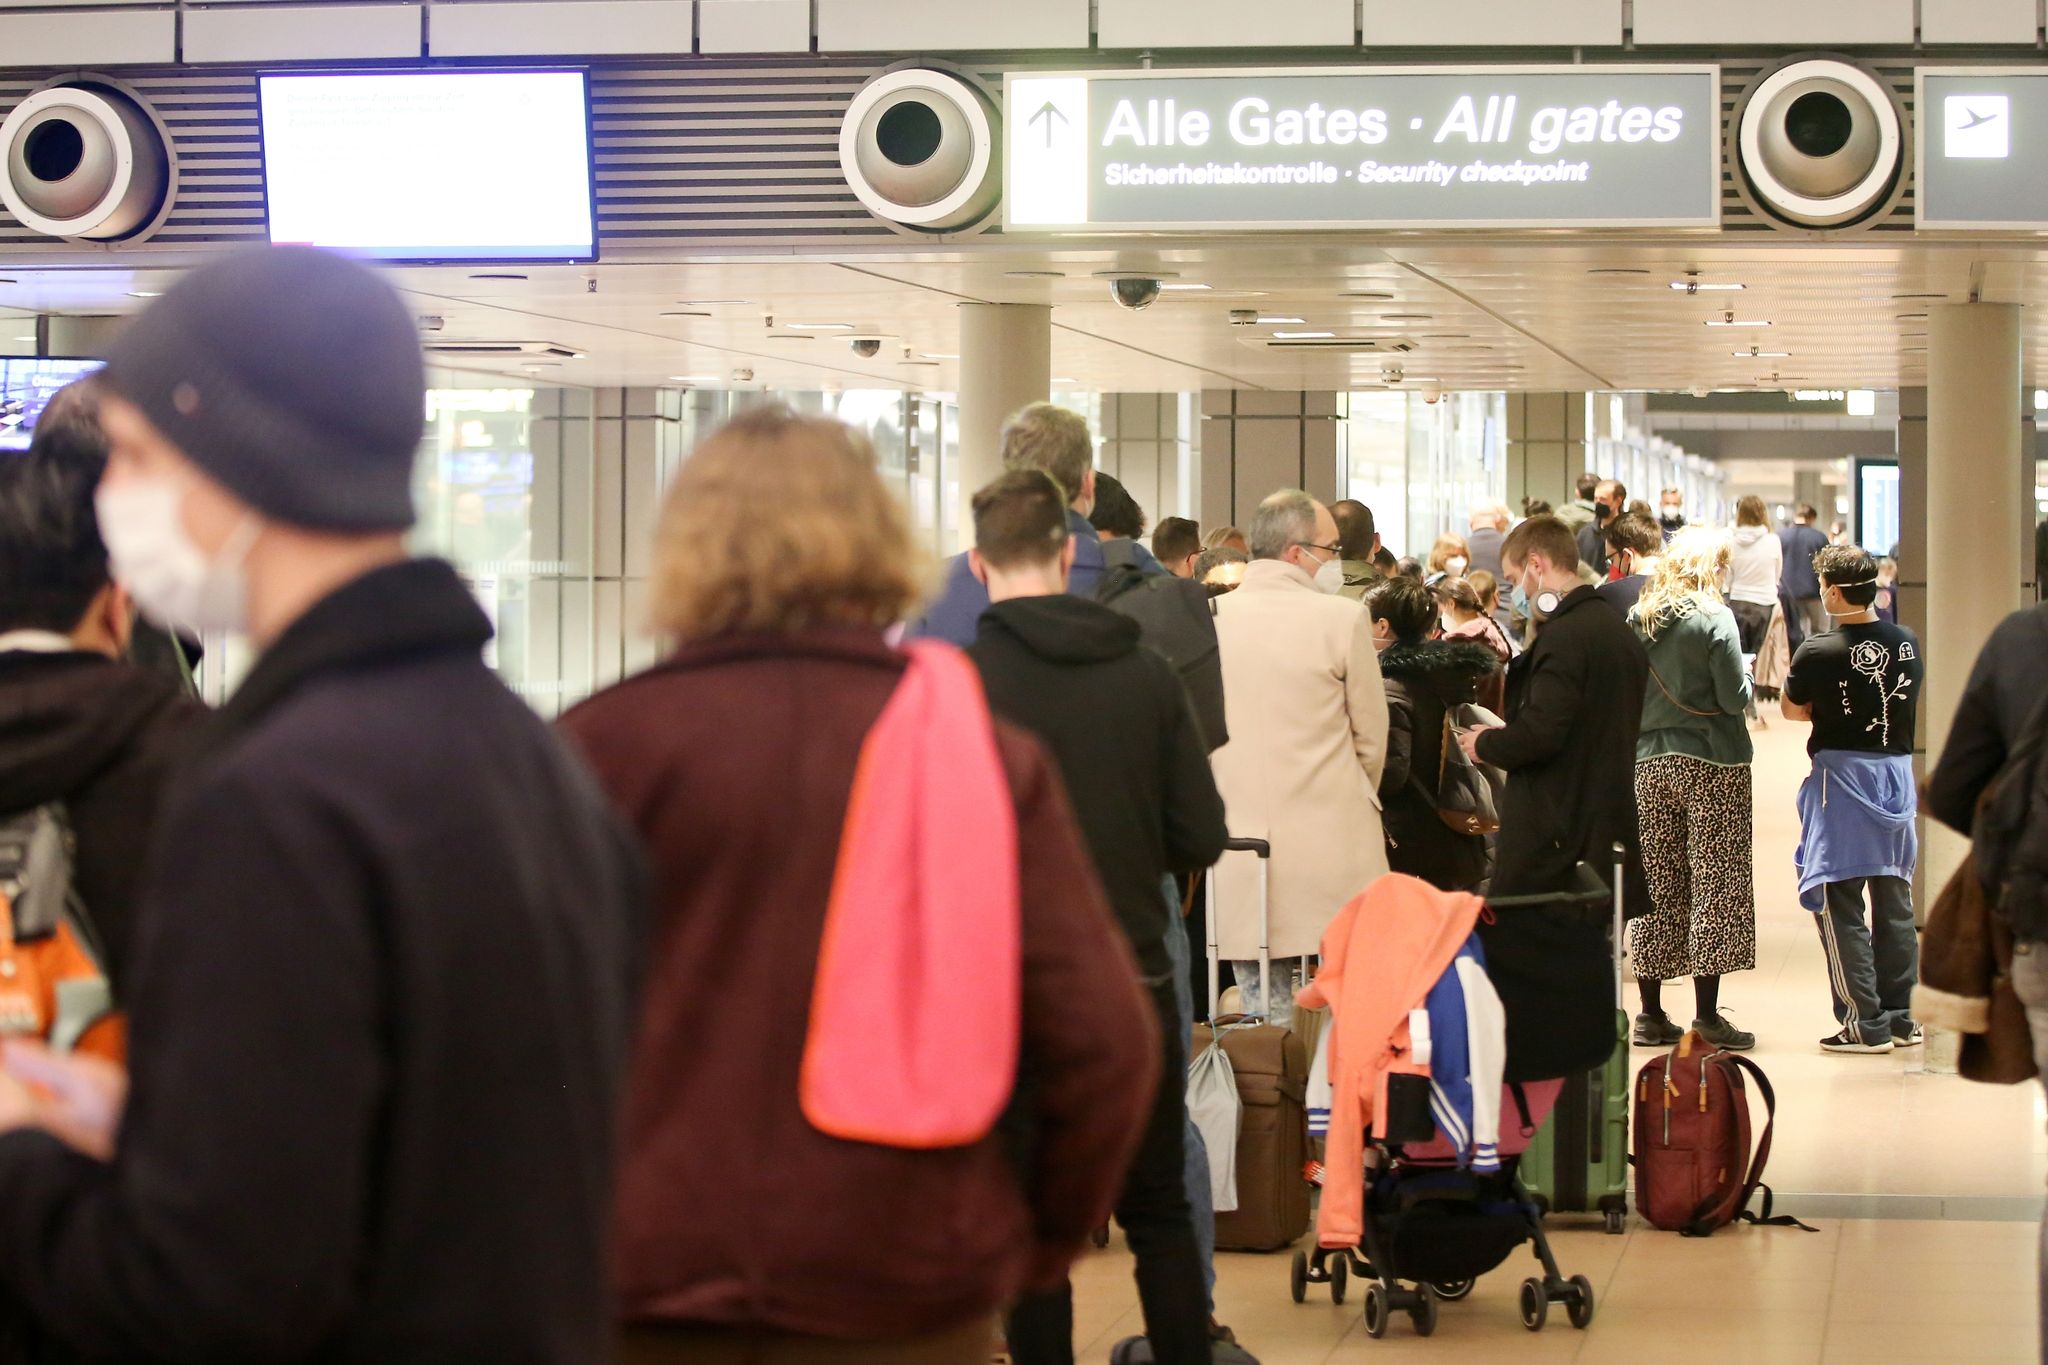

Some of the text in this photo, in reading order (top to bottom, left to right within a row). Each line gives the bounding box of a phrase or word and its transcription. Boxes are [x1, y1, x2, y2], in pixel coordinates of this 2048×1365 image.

[1101, 95, 1683, 155] Alle Gates All gates
[1104, 159, 1589, 187] Sicherheitskontrolle Security checkpoint
[1838, 680, 1852, 716] NICK
